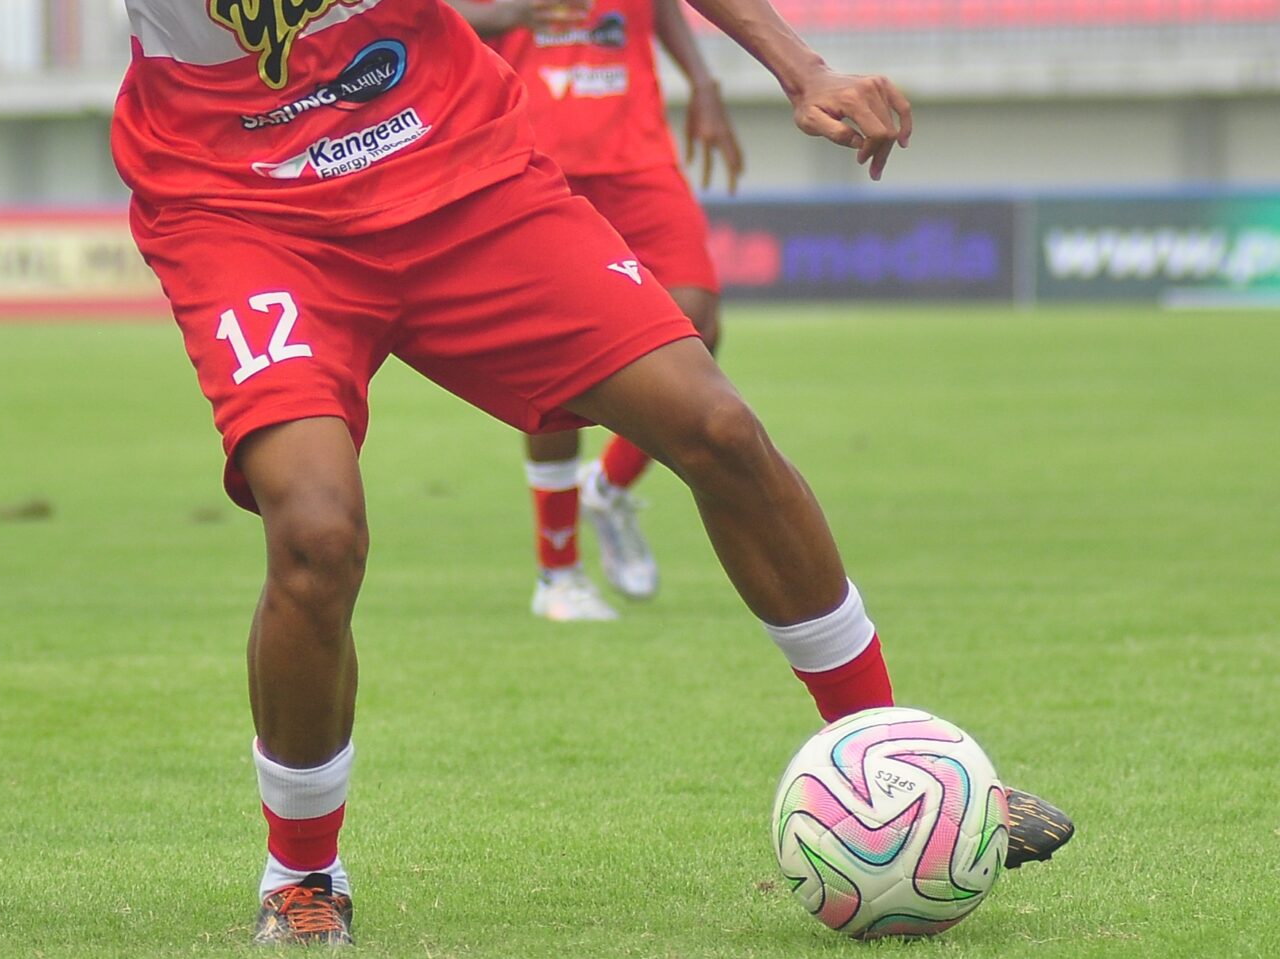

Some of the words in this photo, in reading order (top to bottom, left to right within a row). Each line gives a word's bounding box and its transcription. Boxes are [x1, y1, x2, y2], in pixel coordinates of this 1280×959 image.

[309, 110, 419, 167] Kangean
[320, 154, 368, 179] Energy
[216, 291, 313, 386] 12
